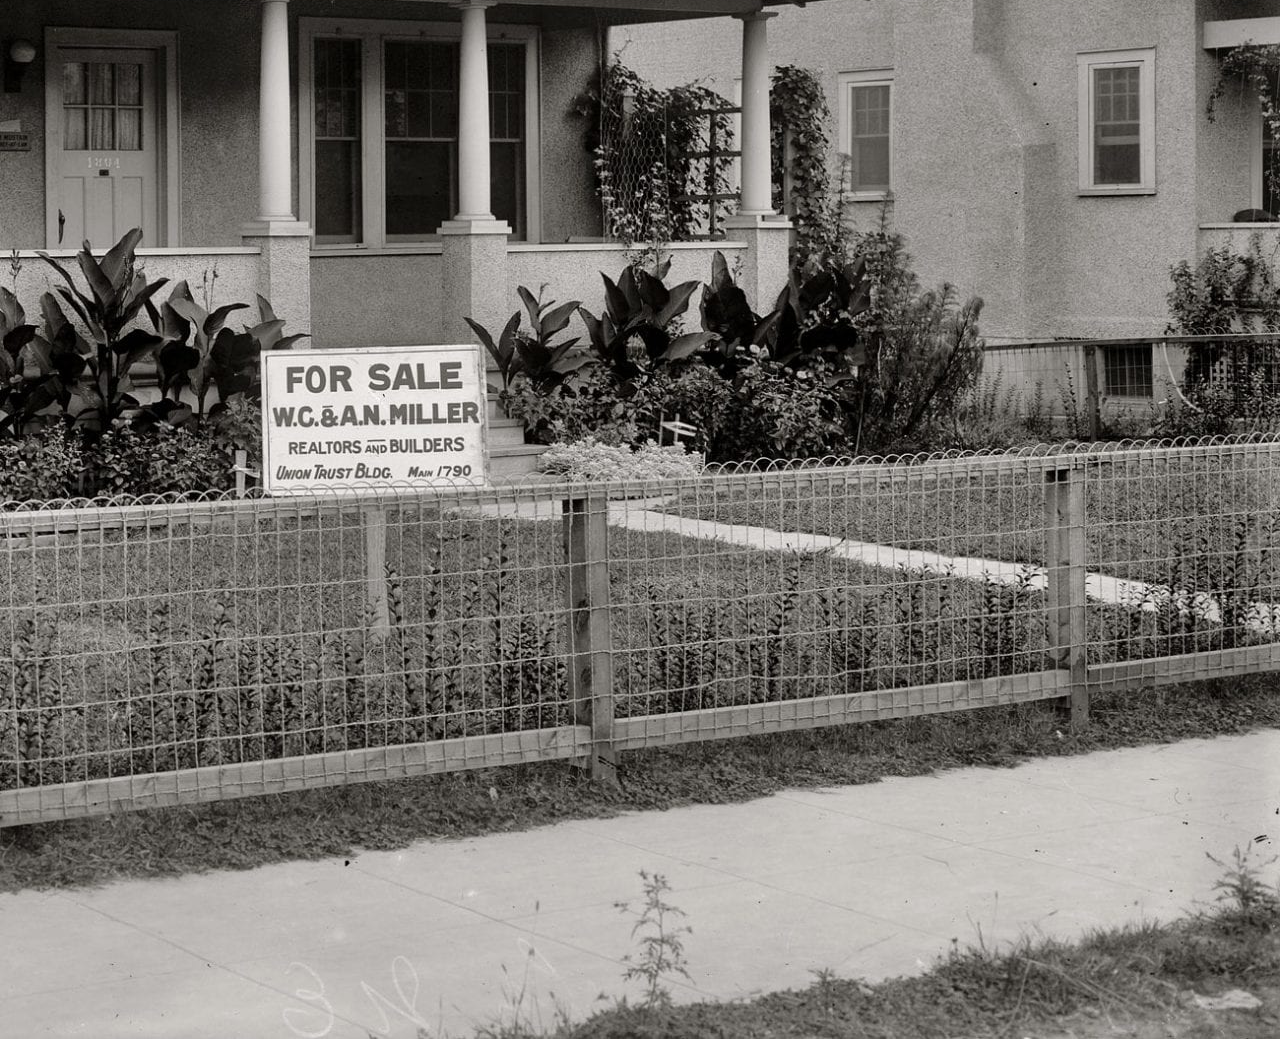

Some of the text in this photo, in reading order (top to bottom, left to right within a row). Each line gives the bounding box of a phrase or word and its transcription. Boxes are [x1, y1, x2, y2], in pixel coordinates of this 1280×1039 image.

[286, 361, 463, 394] FOR SALE
[389, 401, 480, 425] MILLER
[288, 436, 465, 455] REALTORS AND BUILDERS
[276, 465, 311, 480] UNION
[314, 464, 353, 479] TRUST
[436, 465, 472, 477] 1790
